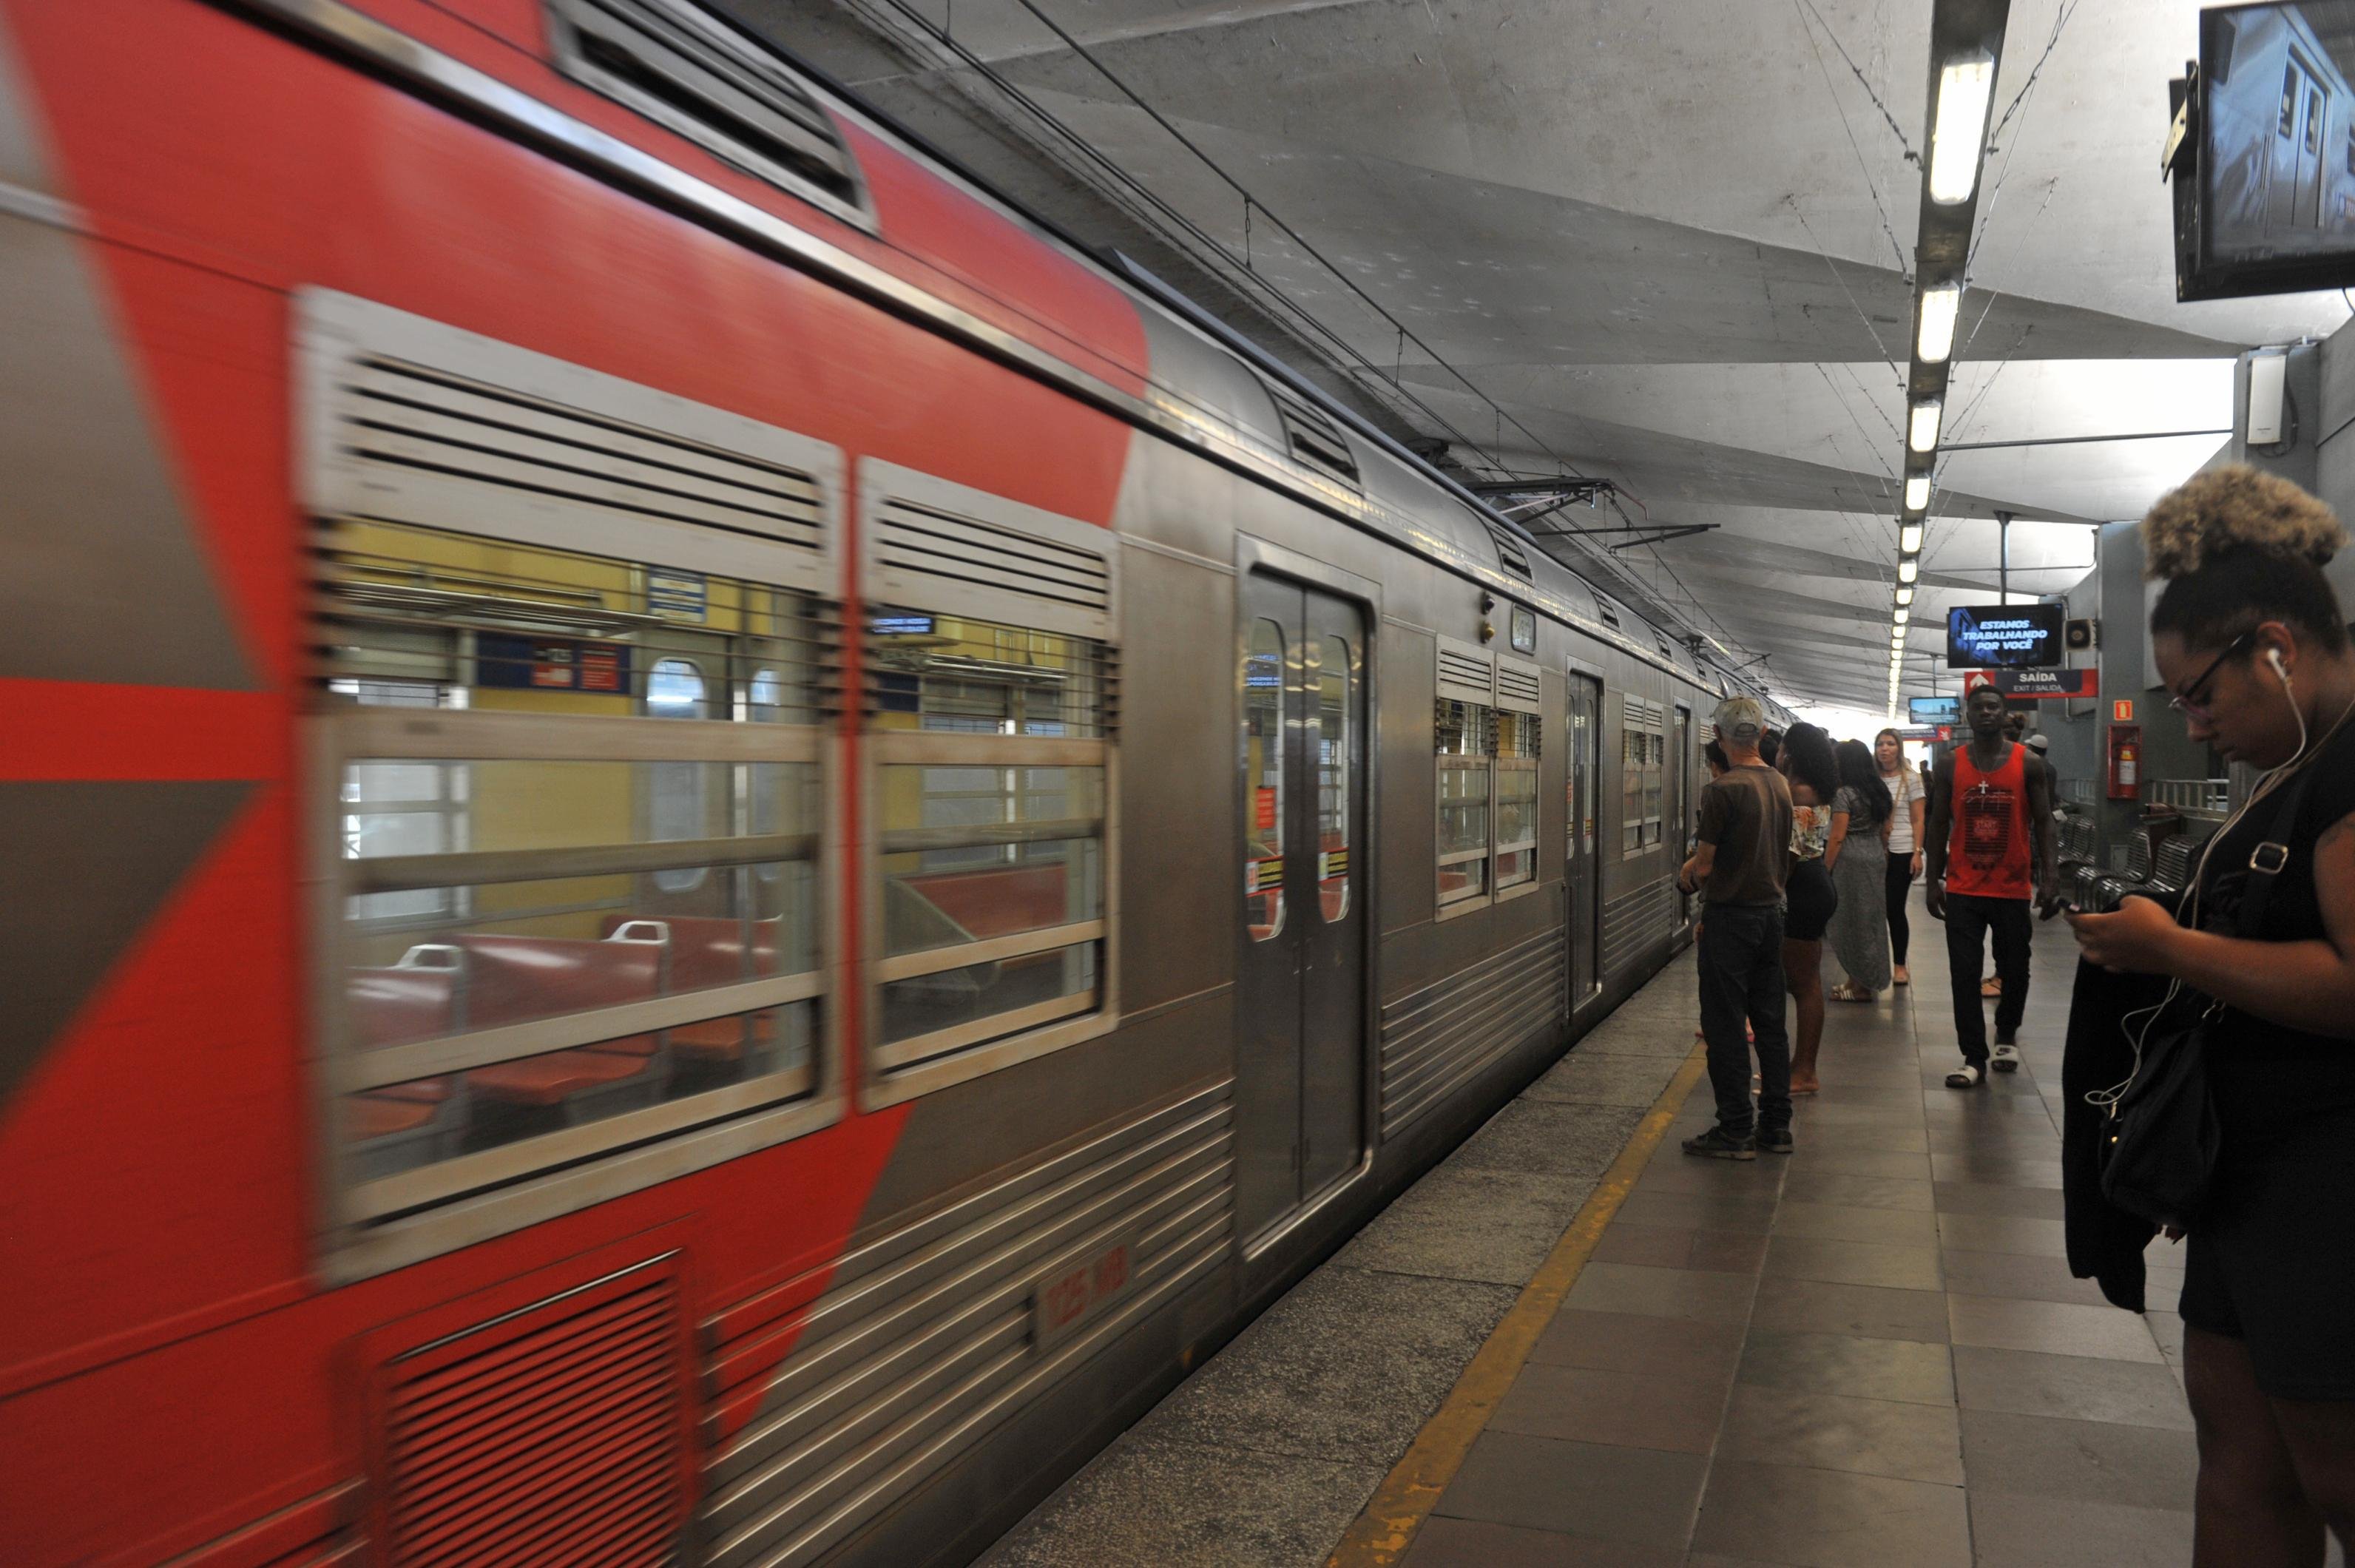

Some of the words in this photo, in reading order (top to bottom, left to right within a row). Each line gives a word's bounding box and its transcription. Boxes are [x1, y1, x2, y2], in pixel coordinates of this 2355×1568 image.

[1979, 620, 2030, 629] ESTAMOS
[1963, 629, 2048, 640] TRABALHANDO
[1976, 641, 2000, 650] POR
[2002, 638, 2033, 649] VOCÊ
[2019, 672, 2058, 682] SAÍDA
[2035, 684, 2063, 692] SALIDA
